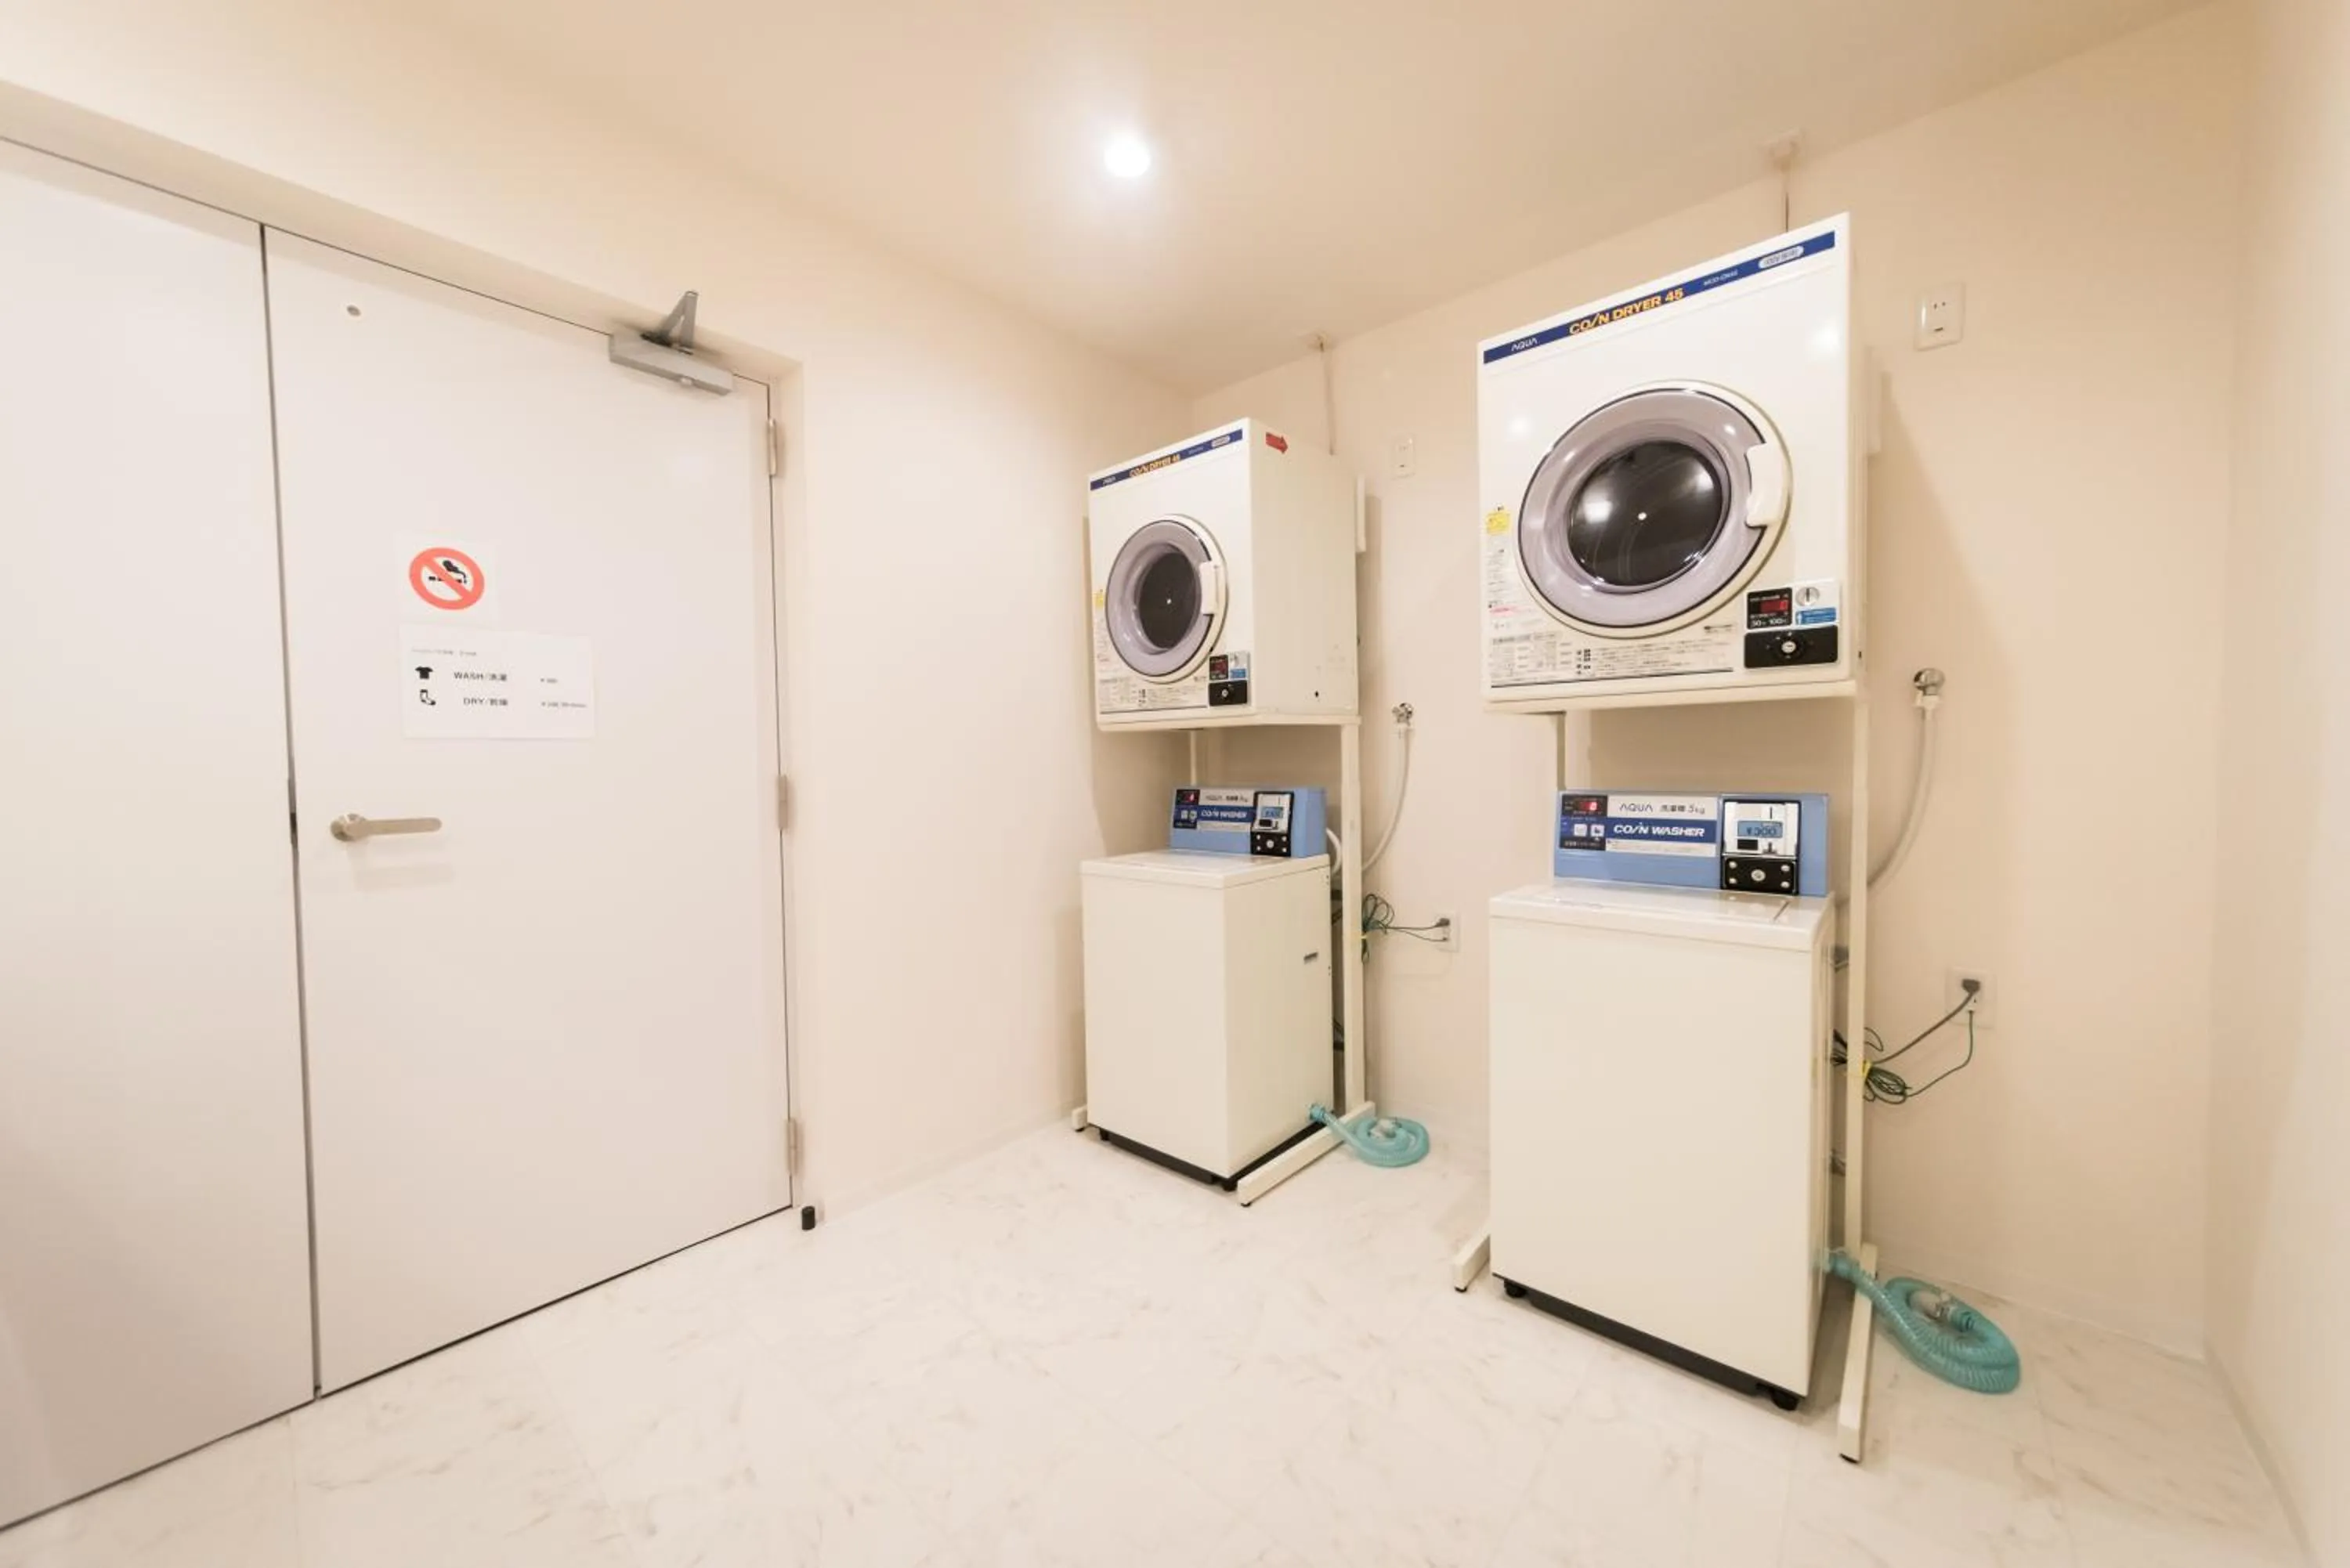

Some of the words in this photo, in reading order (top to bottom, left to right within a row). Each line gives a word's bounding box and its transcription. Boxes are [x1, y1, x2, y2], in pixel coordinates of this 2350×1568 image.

[1613, 296, 1661, 320] DRYER
[1665, 287, 1683, 302] 45
[1619, 803, 1653, 813] AQUA
[1651, 826, 1705, 837] WASHER
